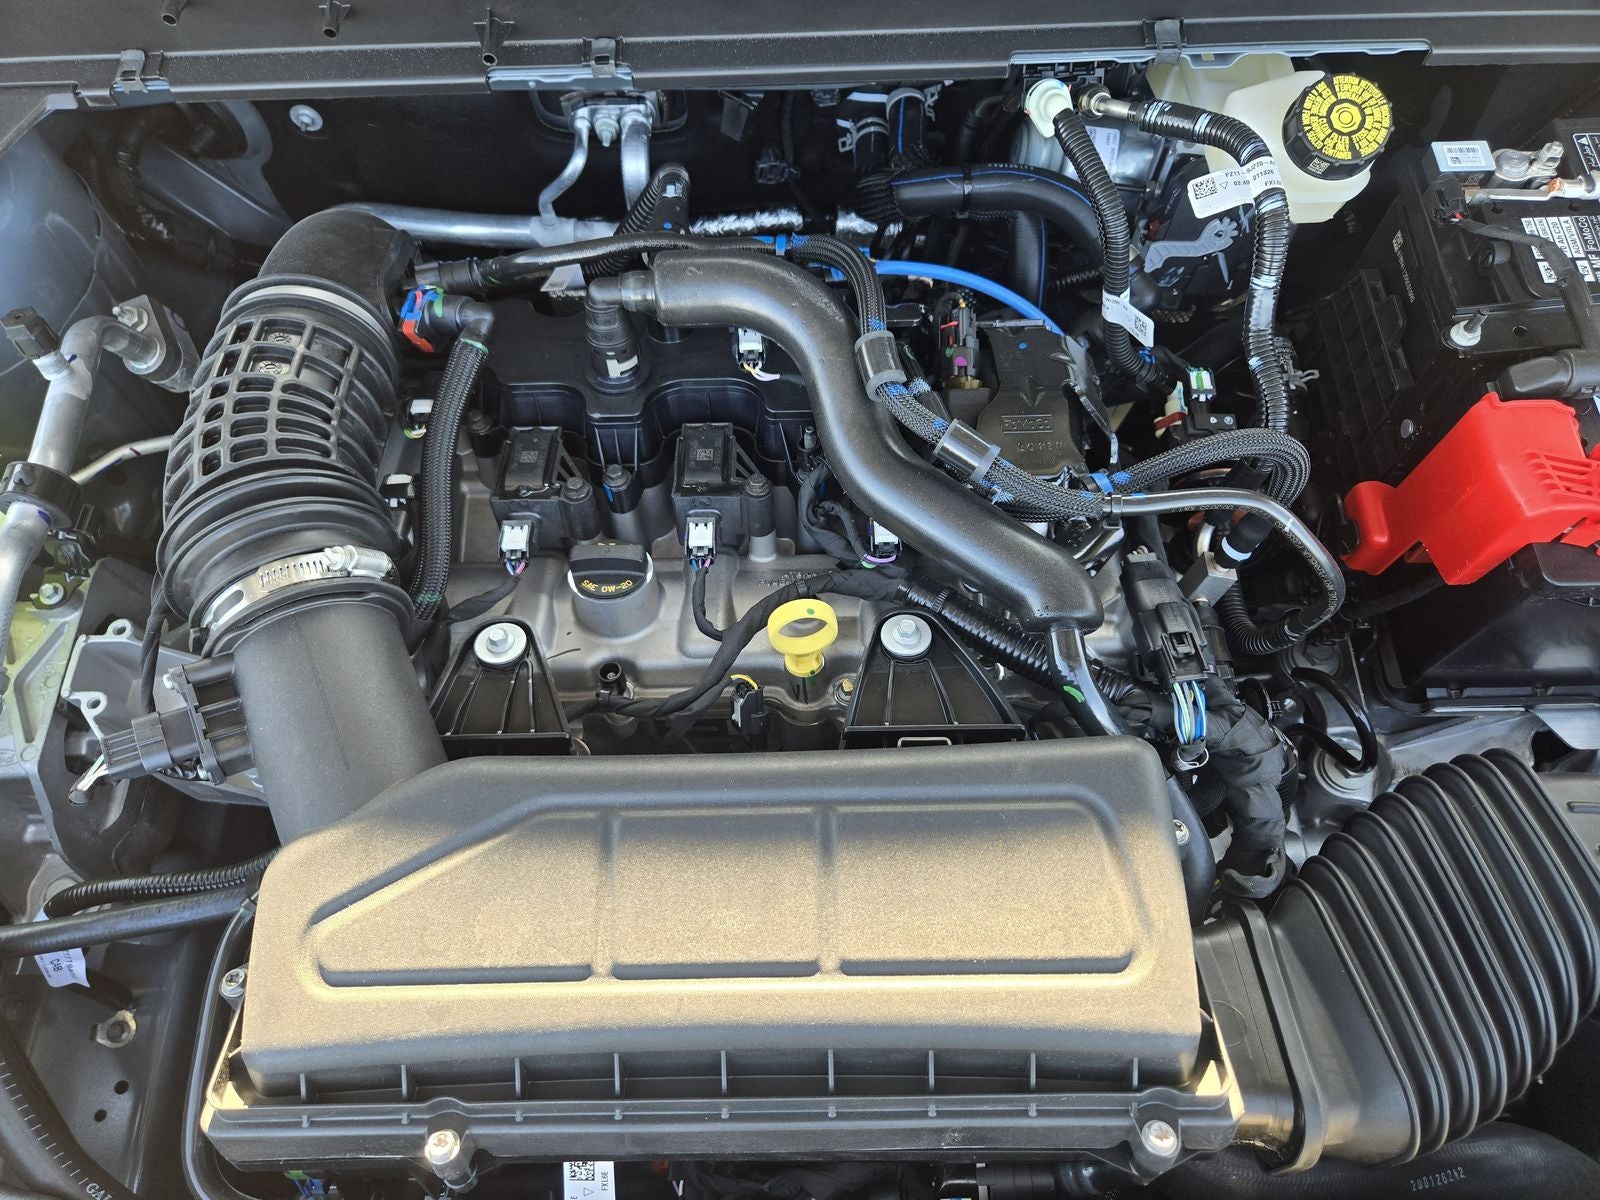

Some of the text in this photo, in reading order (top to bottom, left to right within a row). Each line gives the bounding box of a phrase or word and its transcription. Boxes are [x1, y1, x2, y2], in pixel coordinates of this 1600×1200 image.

[1578, 217, 1597, 250] FoMoCo
[581, 579, 633, 593] SAE 0W-20
